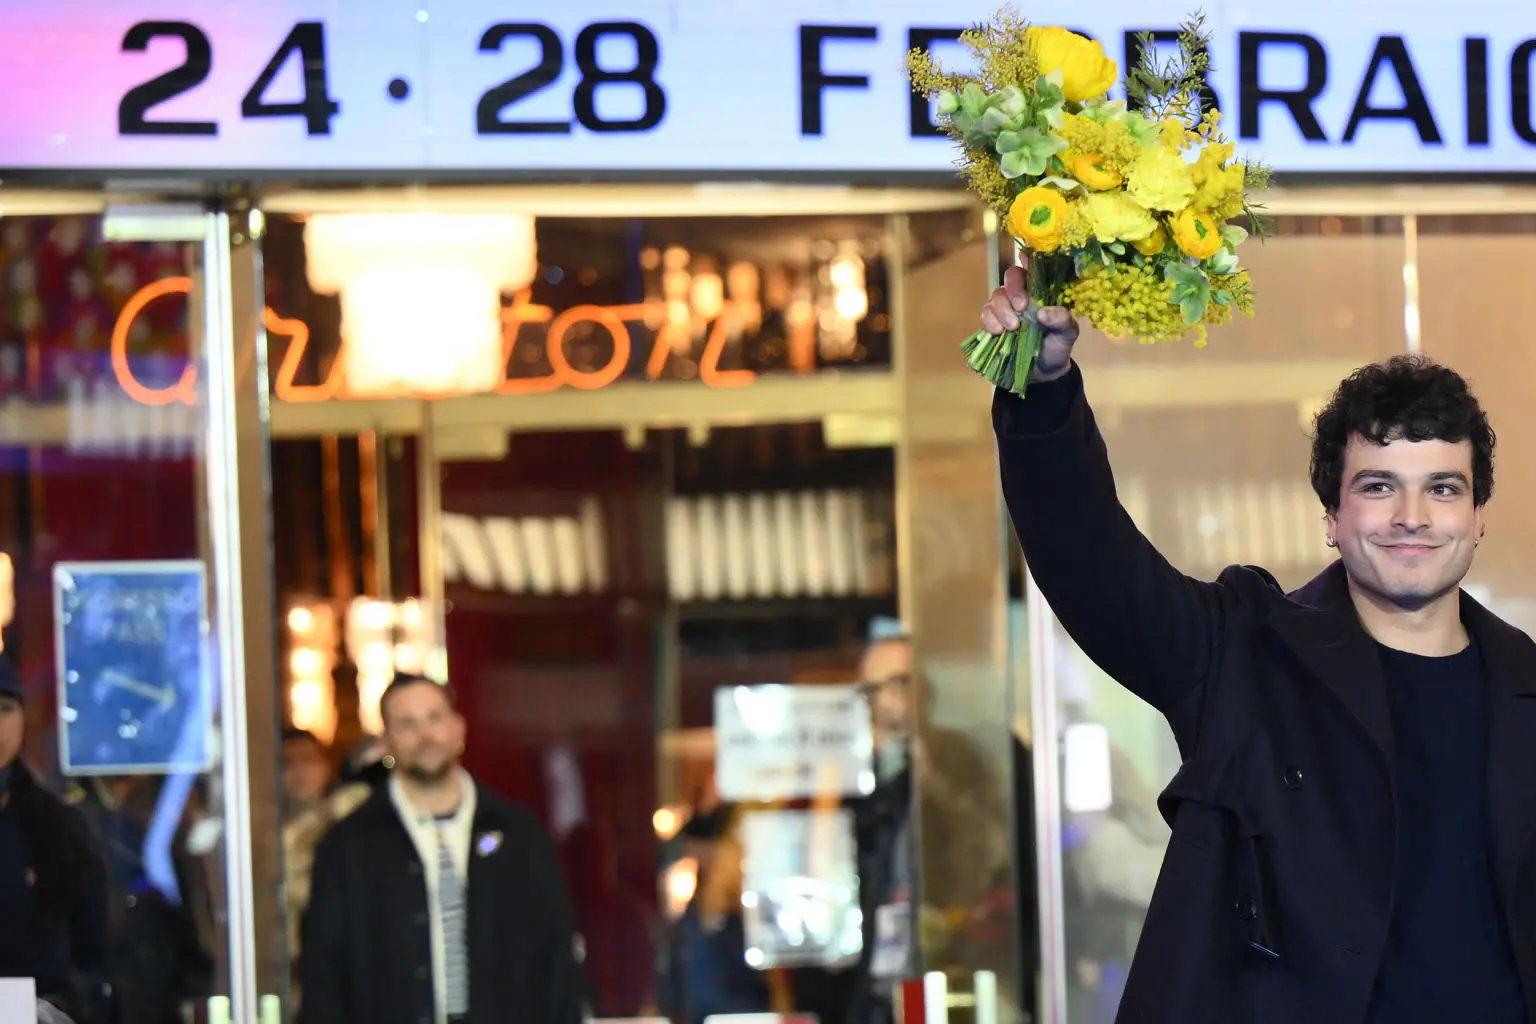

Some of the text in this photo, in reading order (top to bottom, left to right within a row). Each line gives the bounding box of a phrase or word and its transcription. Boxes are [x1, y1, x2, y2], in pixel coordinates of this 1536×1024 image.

[119, 21, 337, 135] 24
[477, 22, 664, 133] 28
[111, 274, 758, 405] Arton
